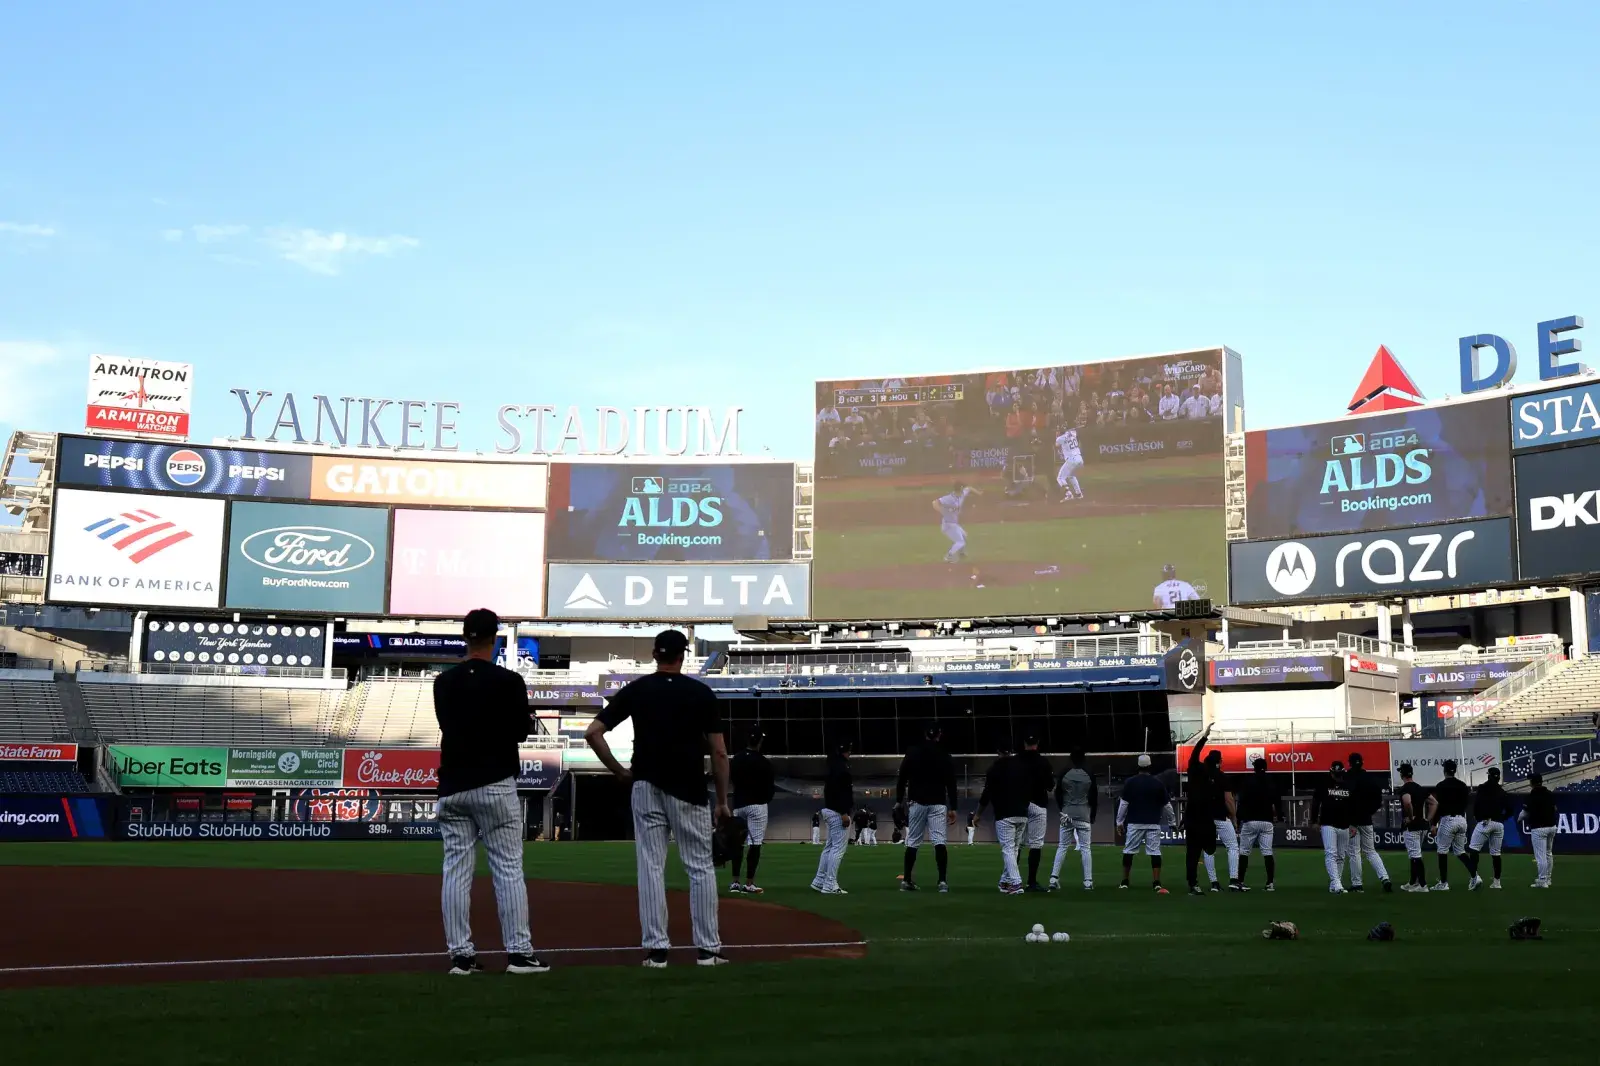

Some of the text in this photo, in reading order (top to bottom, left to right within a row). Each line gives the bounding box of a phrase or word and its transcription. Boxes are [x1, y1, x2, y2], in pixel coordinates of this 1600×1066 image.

[1459, 315, 1585, 395] DE
[94, 363, 187, 382] ARMITRON
[96, 409, 180, 426] ARMITRON
[229, 388, 743, 456] YANKEE STADIUM
[137, 422, 177, 432] WATCHES
[1099, 441, 1164, 454] POSTSEASON
[1370, 434, 1419, 451] 2024
[83, 453, 144, 472] PEPSI
[168, 461, 204, 474] PEPSI
[228, 465, 285, 482] PEPSI
[1320, 449, 1432, 495] ALDS
[325, 464, 487, 498] GATORA
[667, 483, 712, 494] 2024
[1341, 492, 1432, 513] Booking.com
[618, 496, 722, 528] ALDS
[1530, 490, 1600, 532] DK
[637, 533, 721, 548] Booking.com
[263, 531, 350, 568] Ford
[1335, 530, 1475, 588] razr
[53, 574, 214, 593] BANK OF AMERICA
[262, 577, 349, 589] BuyFordNow.com
[624, 574, 794, 606] DELTA
[198, 636, 272, 652] New York Yankees
[333, 638, 361, 646] oking.com
[403, 638, 426, 646] ALDS
[496, 656, 533, 670] ADS
[1033, 659, 1094, 668] StubHub StubHub
[1099, 657, 1157, 666] StubHub StubHub
[1234, 666, 1261, 677] ALDS
[1282, 666, 1324, 674] Booking.com
[1436, 672, 1465, 683] ALDS
[533, 691, 560, 700] ALDS
[1457, 704, 1494, 713] OYOTA
[232, 749, 277, 761] Morningside
[301, 750, 340, 760] Workmen's
[1269, 752, 1314, 763] TOYOTA
[1421, 759, 1432, 767] OF
[1434, 758, 1475, 766] AMRICA
[114, 757, 222, 776] Uber Eats
[317, 759, 339, 769] Circle
[358, 758, 439, 786] Chick-fil-A
[1327, 789, 1350, 798] YANKEES
[410, 801, 438, 819] SU
[0, 810, 60, 826] king.com
[1556, 813, 1600, 835] ALD
[127, 823, 331, 838] StubHub StubHub StubHub
[403, 826, 434, 835] STARR
[1384, 832, 1405, 844] Stub
